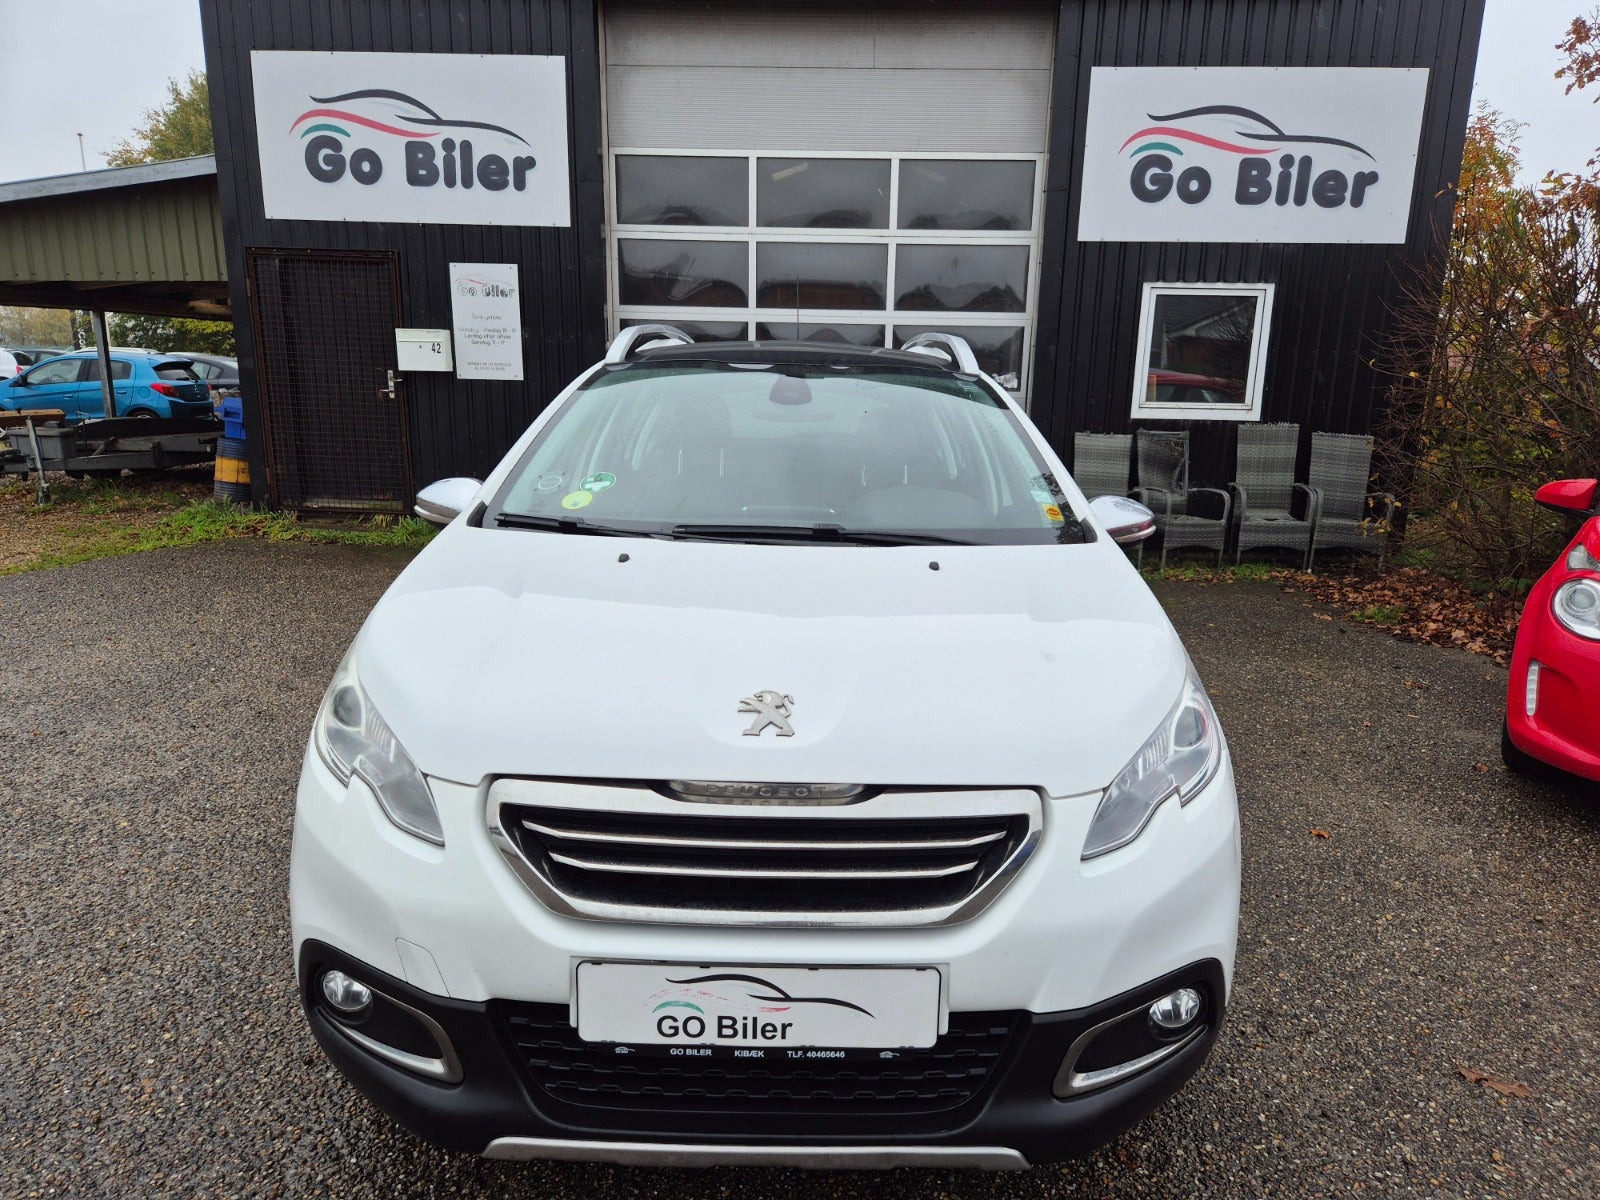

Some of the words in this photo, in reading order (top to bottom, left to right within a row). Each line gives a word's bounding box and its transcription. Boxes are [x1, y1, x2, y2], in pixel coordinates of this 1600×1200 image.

[305, 134, 383, 186] Go
[404, 137, 537, 192] Biler
[1129, 153, 1212, 205] Go
[1234, 153, 1379, 209] Biler
[431, 342, 442, 354] 42
[705, 783, 827, 798] PEUGEOT
[656, 1014, 706, 1039] GO
[716, 1016, 793, 1041] Biler
[669, 1048, 684, 1056] GO
[685, 1048, 712, 1057] BILER
[734, 1049, 765, 1058] KIBÆK
[786, 1050, 804, 1058] TLF.
